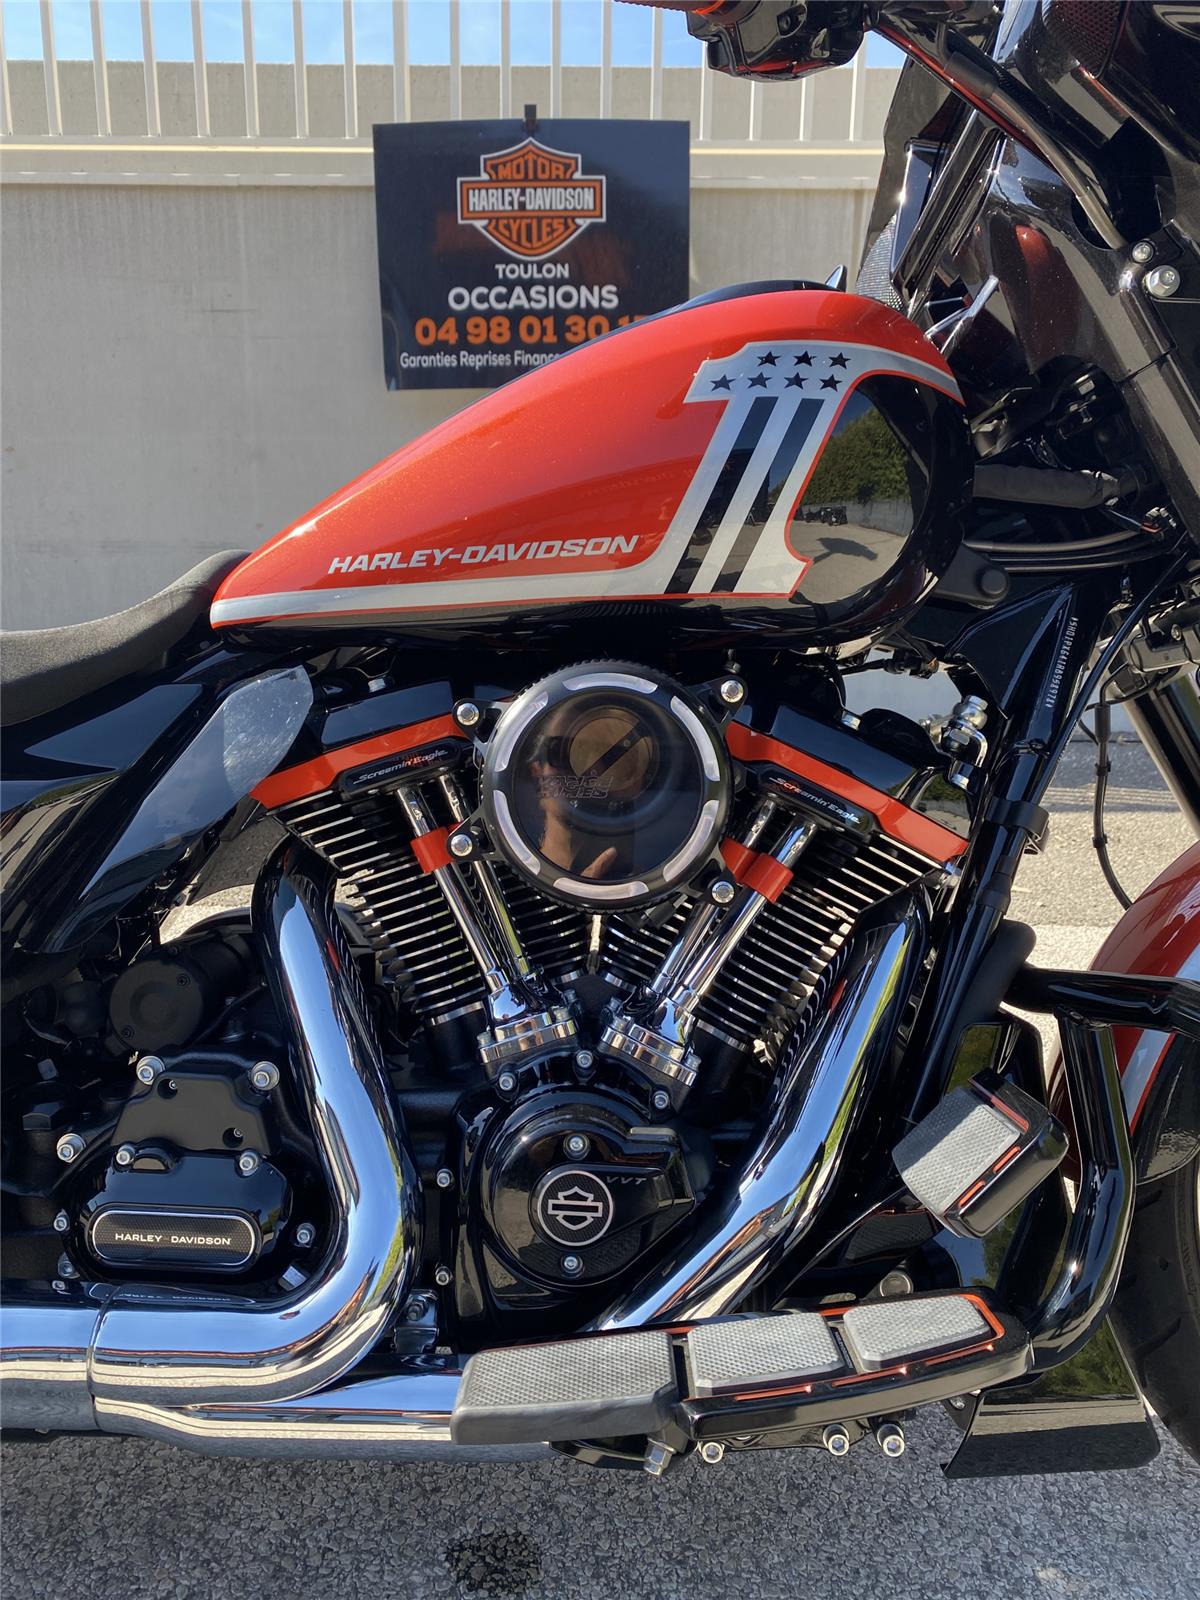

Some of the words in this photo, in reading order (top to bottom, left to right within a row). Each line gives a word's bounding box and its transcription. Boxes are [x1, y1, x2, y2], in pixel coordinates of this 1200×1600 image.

[497, 153, 565, 180] MOTOR
[468, 187, 595, 212] HARLEY-DAVIDSON
[498, 218, 564, 248] CYCLES
[495, 264, 570, 279] TOULON
[448, 285, 619, 311] OCCASIONS
[415, 316, 459, 346] 04
[466, 316, 512, 345] 98
[519, 316, 558, 344] 01
[564, 314, 610, 344] 30
[400, 351, 457, 369] Garanties
[460, 351, 512, 370] Reprises
[328, 535, 640, 575] HARLEY-DAVIDSON
[606, 1175, 648, 1185] VVT
